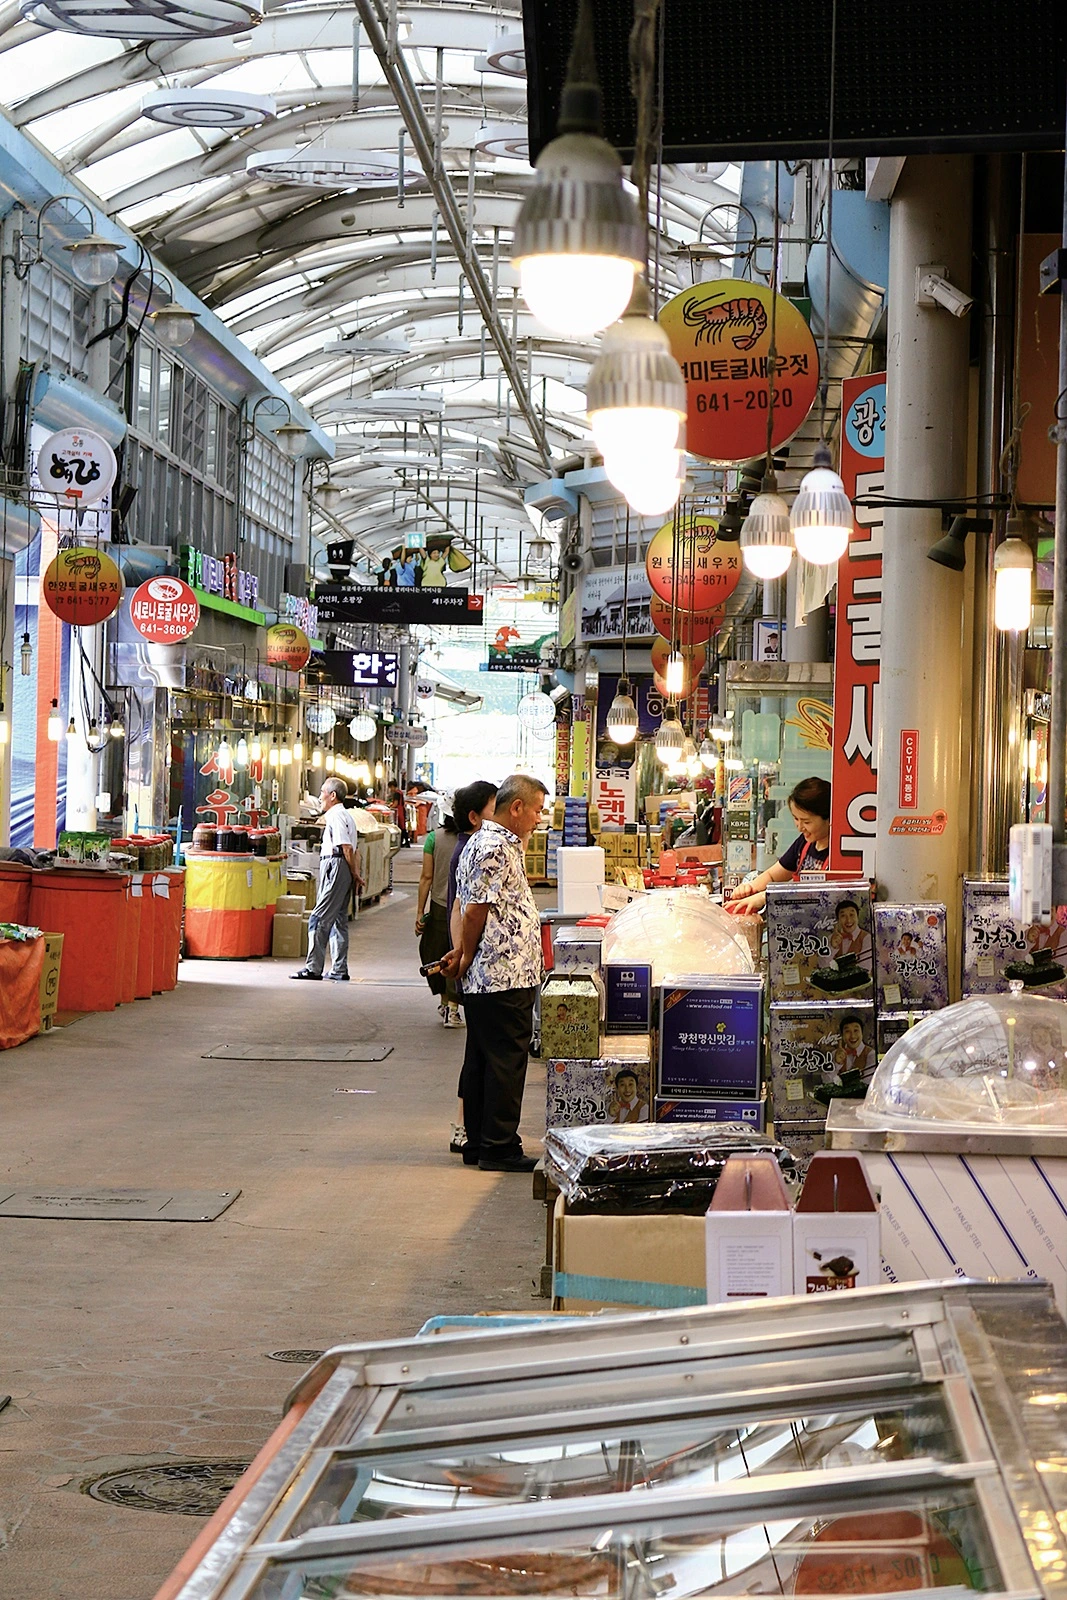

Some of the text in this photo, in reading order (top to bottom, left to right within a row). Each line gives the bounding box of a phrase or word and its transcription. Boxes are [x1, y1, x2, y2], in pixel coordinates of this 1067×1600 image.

[681, 353, 810, 386] 미토굴새우젓
[696, 387, 793, 413] 641-2020
[851, 397, 886, 447] 광
[341, 595, 363, 604] 소광장
[431, 597, 464, 606] 제1주차장
[139, 622, 188, 636] 641-3608
[776, 934, 831, 959] 광천김
[972, 926, 1027, 951] 광천김
[896, 959, 938, 979] 광천김
[678, 1032, 736, 1046] 광천명신맛김
[779, 1049, 836, 1075] 광천김
[553, 1097, 608, 1121] 광천김
[881, 1203, 911, 1249] STAINLESS STEEL
[952, 1205, 982, 1250] STAINLESS STEEL
[1025, 1207, 1055, 1252] STAINLESS STEEL
